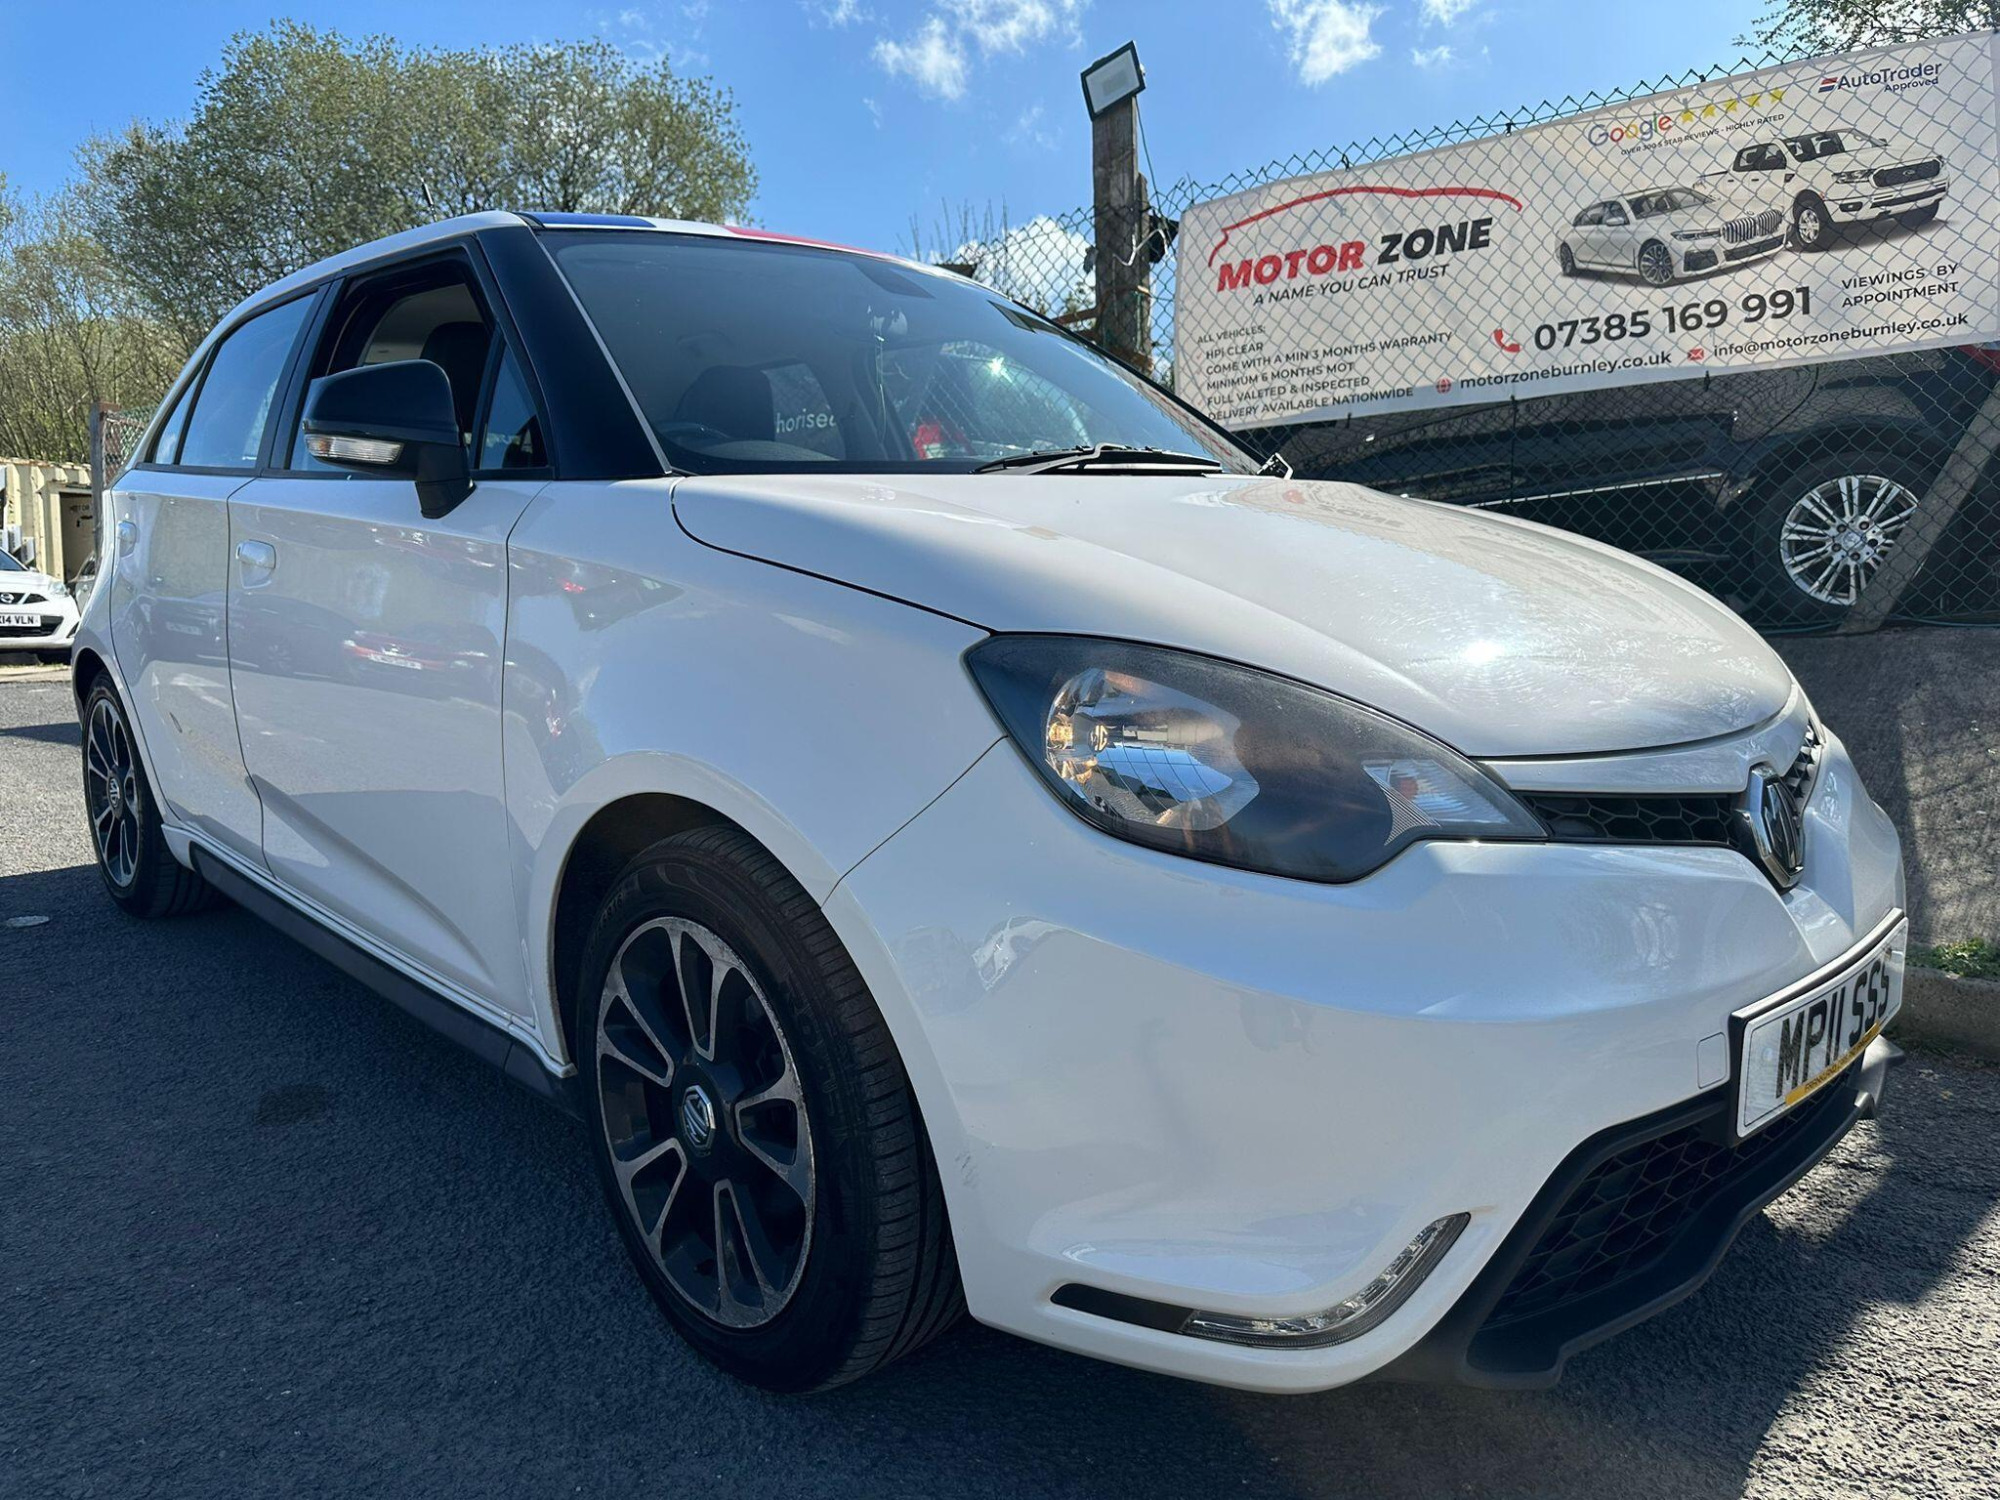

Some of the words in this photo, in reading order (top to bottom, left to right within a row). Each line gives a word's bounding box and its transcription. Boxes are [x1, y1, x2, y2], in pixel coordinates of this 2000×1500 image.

[1838, 63, 1942, 89] AutoTrader
[1884, 77, 1938, 92] Approved
[1588, 112, 1672, 146] Google
[1621, 145, 1641, 155] OVER
[1664, 136, 1683, 146] STAR
[1684, 128, 1719, 141] REVIEWS
[1726, 120, 1755, 132] HIGHLY
[1757, 113, 1785, 125] RATED
[1217, 241, 1366, 292] MOTOR
[1377, 217, 1493, 265] ZONE
[1253, 294, 1264, 306] A
[1268, 285, 1315, 303] NAME
[1320, 280, 1354, 295] YOU
[1358, 274, 1392, 290] CAN
[1397, 264, 1450, 283] TRUST
[1841, 268, 1926, 290] VIEWINGS
[1936, 263, 1958, 277] BY
[1841, 281, 1959, 308] APPOINTMENT
[1198, 335, 1214, 344] ALL
[1216, 325, 1266, 340] VEHICLES:
[1534, 310, 1651, 351] 07385
[1662, 299, 1728, 334] 169
[1741, 286, 1811, 323] 991
[1714, 312, 1969, 357] info@motorzoneburnley.co.uk
[1206, 347, 1225, 359] HPI
[1227, 342, 1264, 356] CLEAR
[1206, 361, 1239, 375] COME
[1241, 356, 1271, 369] WITH
[1274, 354, 1282, 364] A
[1286, 351, 1309, 362] MIN
[1312, 350, 1319, 359] 3
[1322, 342, 1376, 358] MONTHS
[1379, 332, 1452, 350] WARRANTY
[1207, 374, 1258, 390] MINIMUM
[1261, 372, 1268, 381] 6
[1270, 365, 1323, 379] MONTHS
[1326, 362, 1355, 373] MOT
[1460, 351, 1672, 389] motorzoneburnley.co.uk
[1207, 395, 1234, 406] FULL
[1236, 386, 1287, 401] VALETED
[1289, 384, 1298, 394] &
[1301, 376, 1369, 393] INSPECTED
[1208, 405, 1259, 420] DELIVERY
[1261, 396, 1329, 412] AVAILABLE
[1332, 387, 1414, 406] NATIONWIDE
[0, 616, 11, 624] 14
[14, 615, 34, 624] VLN
[1776, 986, 1847, 1099] MP11
